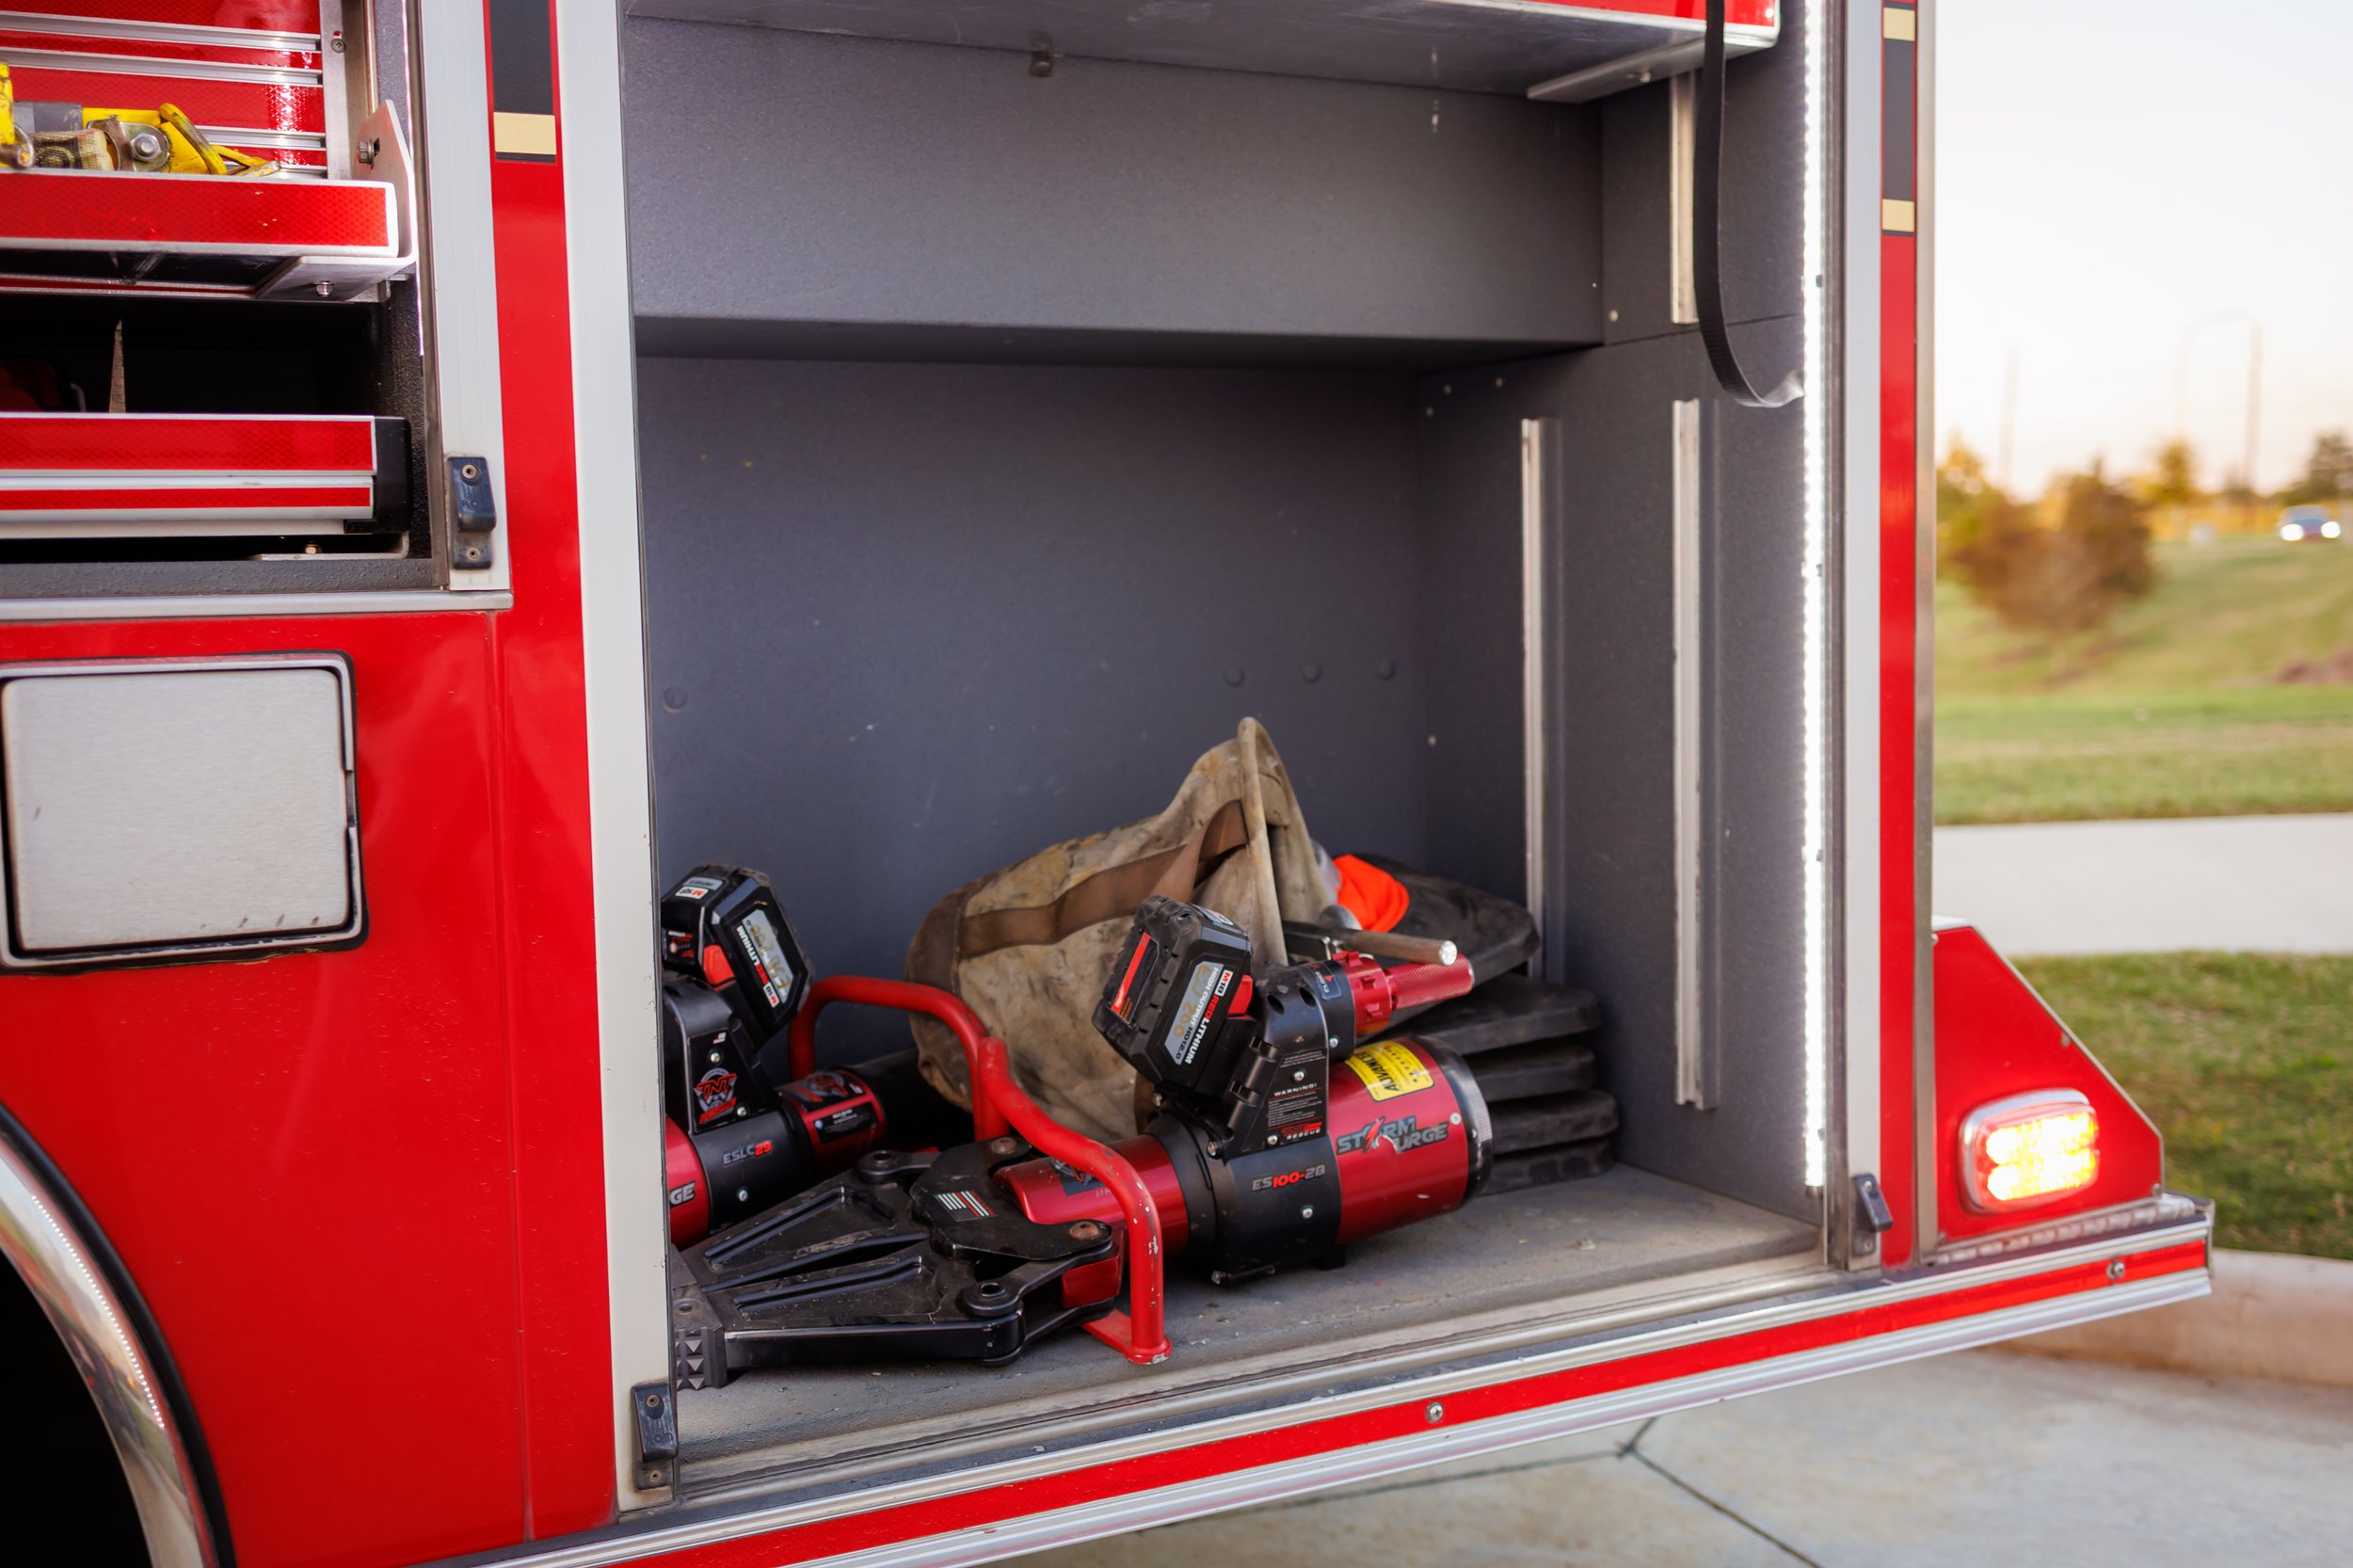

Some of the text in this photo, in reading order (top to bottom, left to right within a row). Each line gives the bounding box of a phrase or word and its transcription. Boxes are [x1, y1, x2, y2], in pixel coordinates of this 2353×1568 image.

[1206, 968, 1220, 991] HIGH
[1218, 971, 1231, 994] M18
[1190, 991, 1209, 1027] OUTPUT
[1185, 994, 1220, 1064] REDLITHIUM
[1176, 1026, 1193, 1060] HD12.0
[696, 1073, 737, 1099] TNT
[1273, 1083, 1318, 1097] WARNING!
[1393, 1122, 1449, 1153] URGE
[723, 1141, 773, 1165] ESLC29
